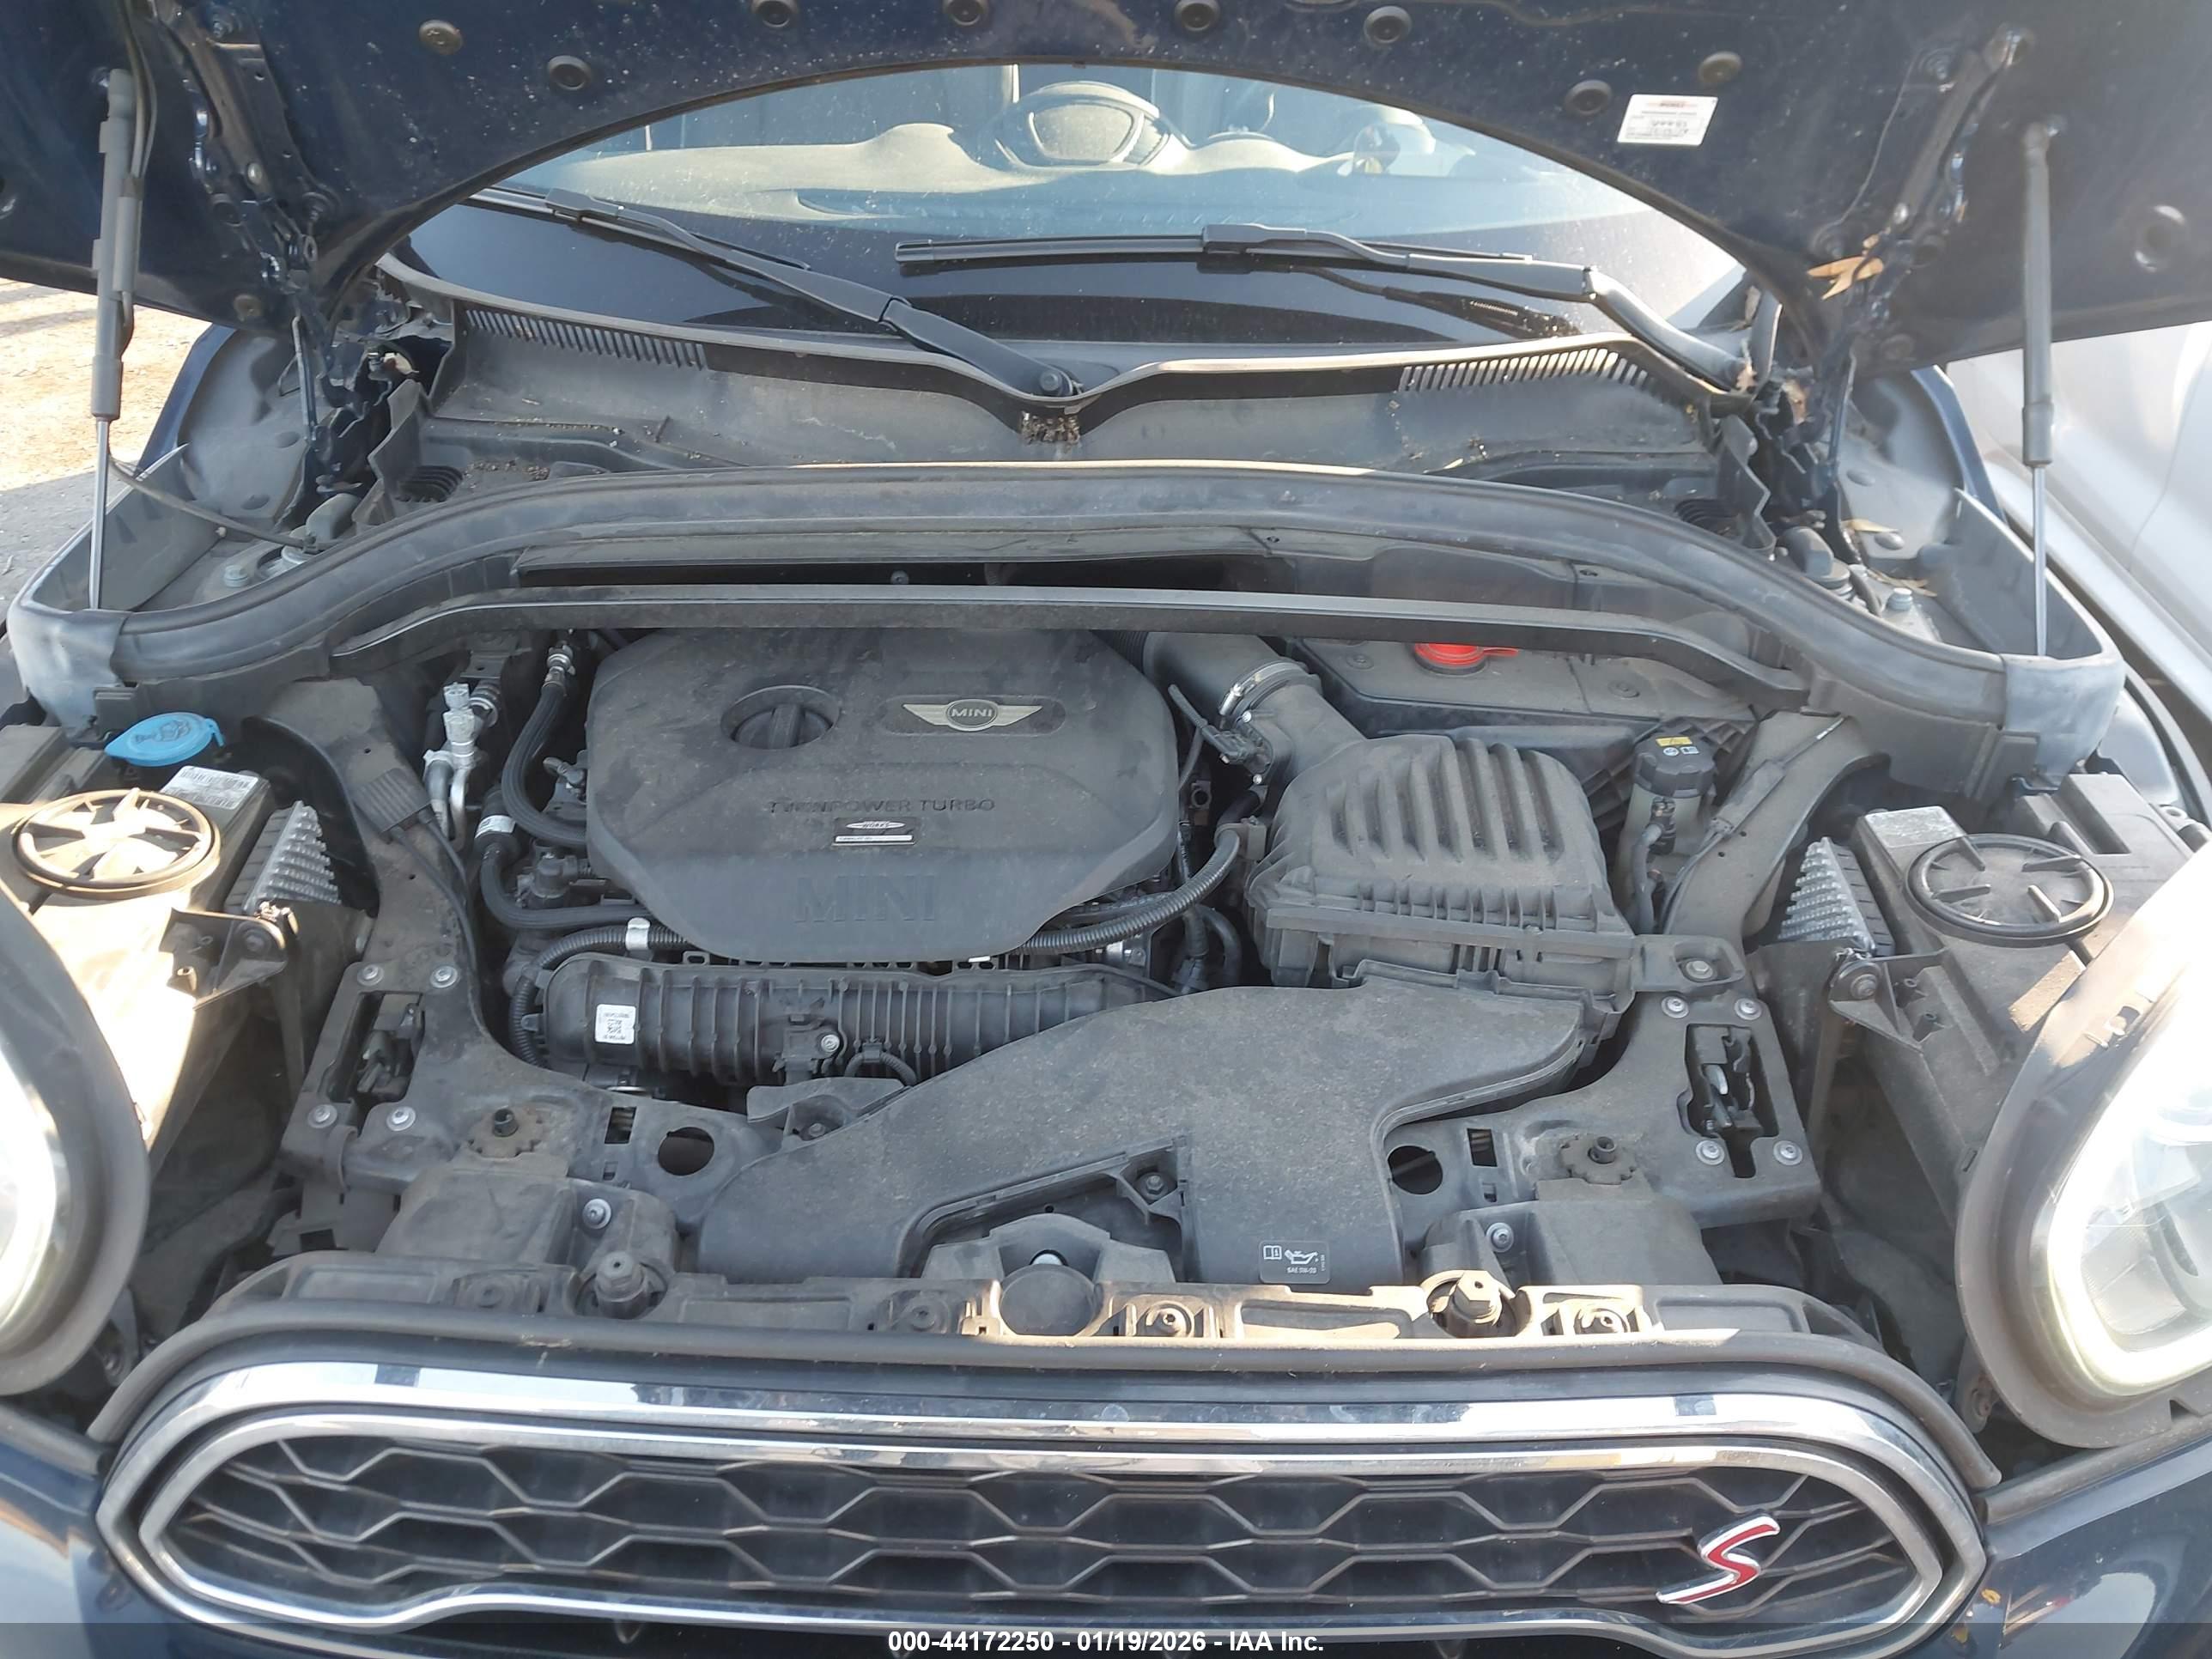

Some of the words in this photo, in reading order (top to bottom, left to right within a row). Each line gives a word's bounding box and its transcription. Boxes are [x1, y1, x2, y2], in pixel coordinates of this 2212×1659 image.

[951, 708, 994, 718] MINI
[920, 799, 995, 812] TURBO
[794, 875, 936, 923] MINI
[1656, 1516, 1780, 1604] S
